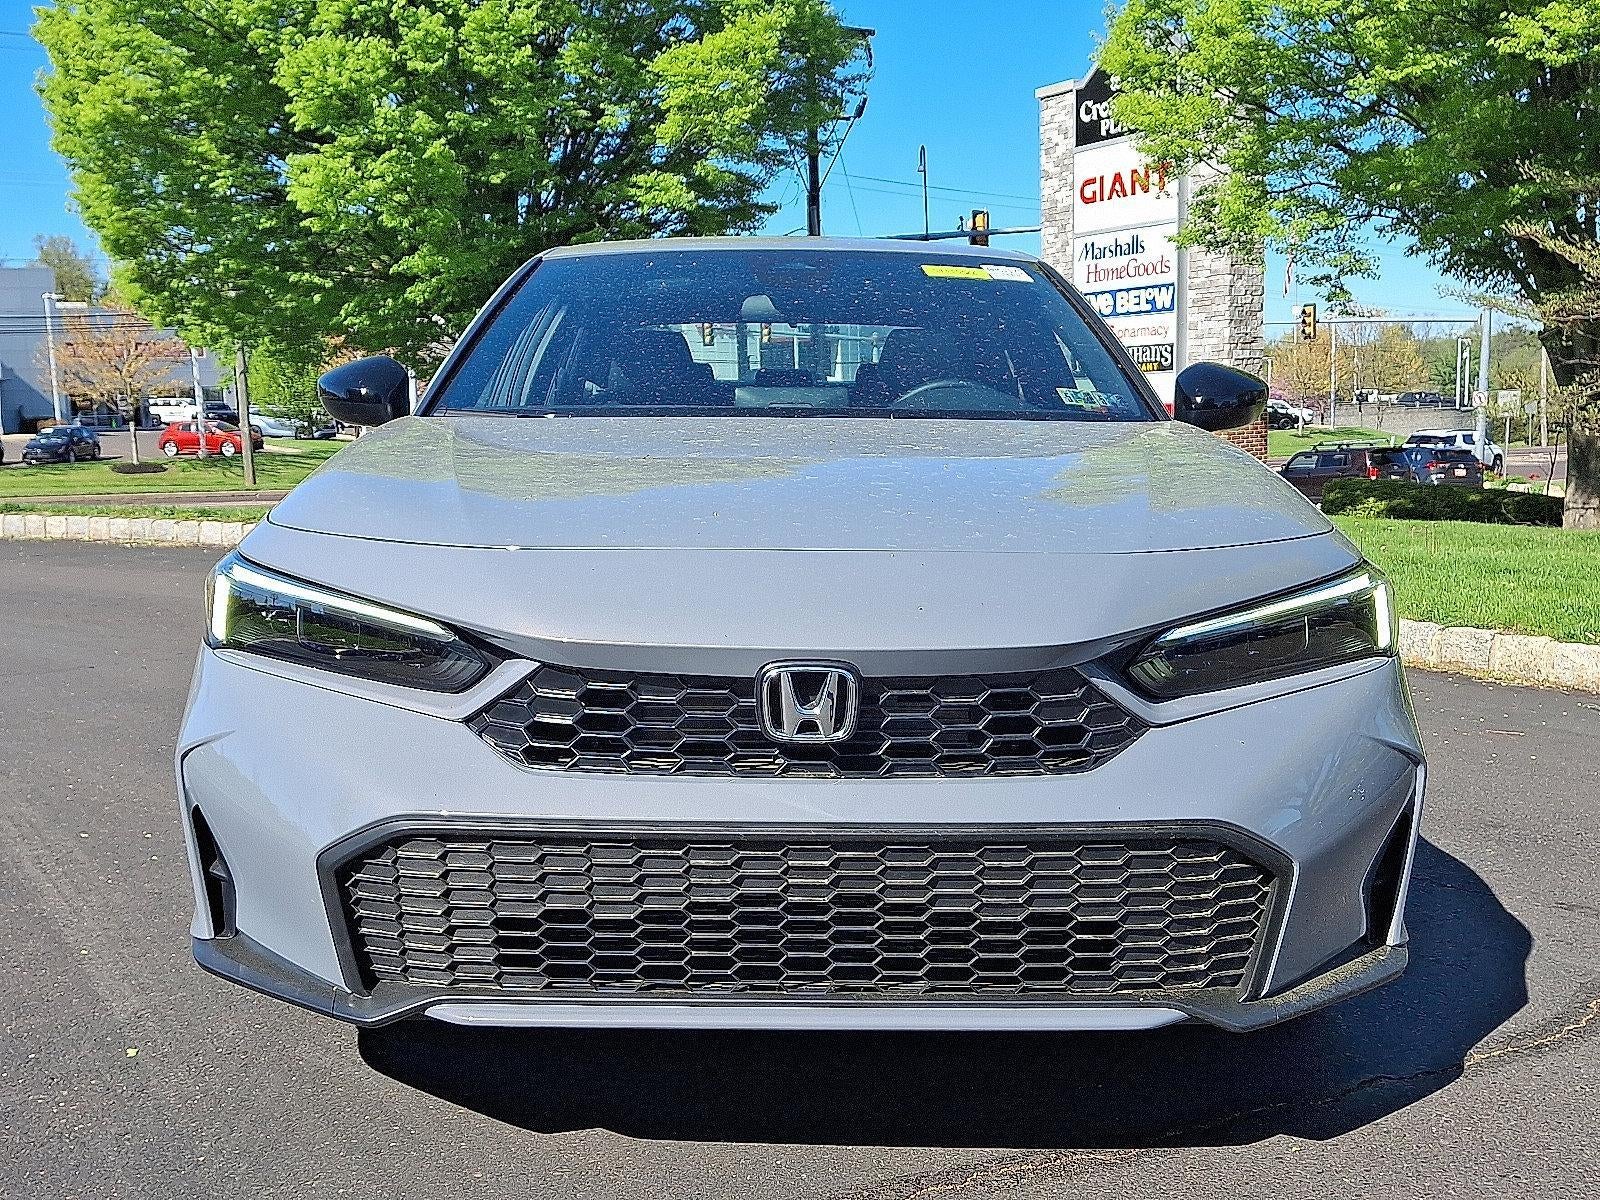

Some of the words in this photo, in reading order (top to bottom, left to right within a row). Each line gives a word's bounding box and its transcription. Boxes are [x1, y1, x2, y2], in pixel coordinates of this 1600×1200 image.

[1079, 99, 1112, 123] Cro
[1079, 161, 1173, 205] GIANT
[1078, 234, 1145, 262] Marshalls
[1086, 254, 1171, 283] HomeGoods
[1117, 323, 1169, 340] pharmacy
